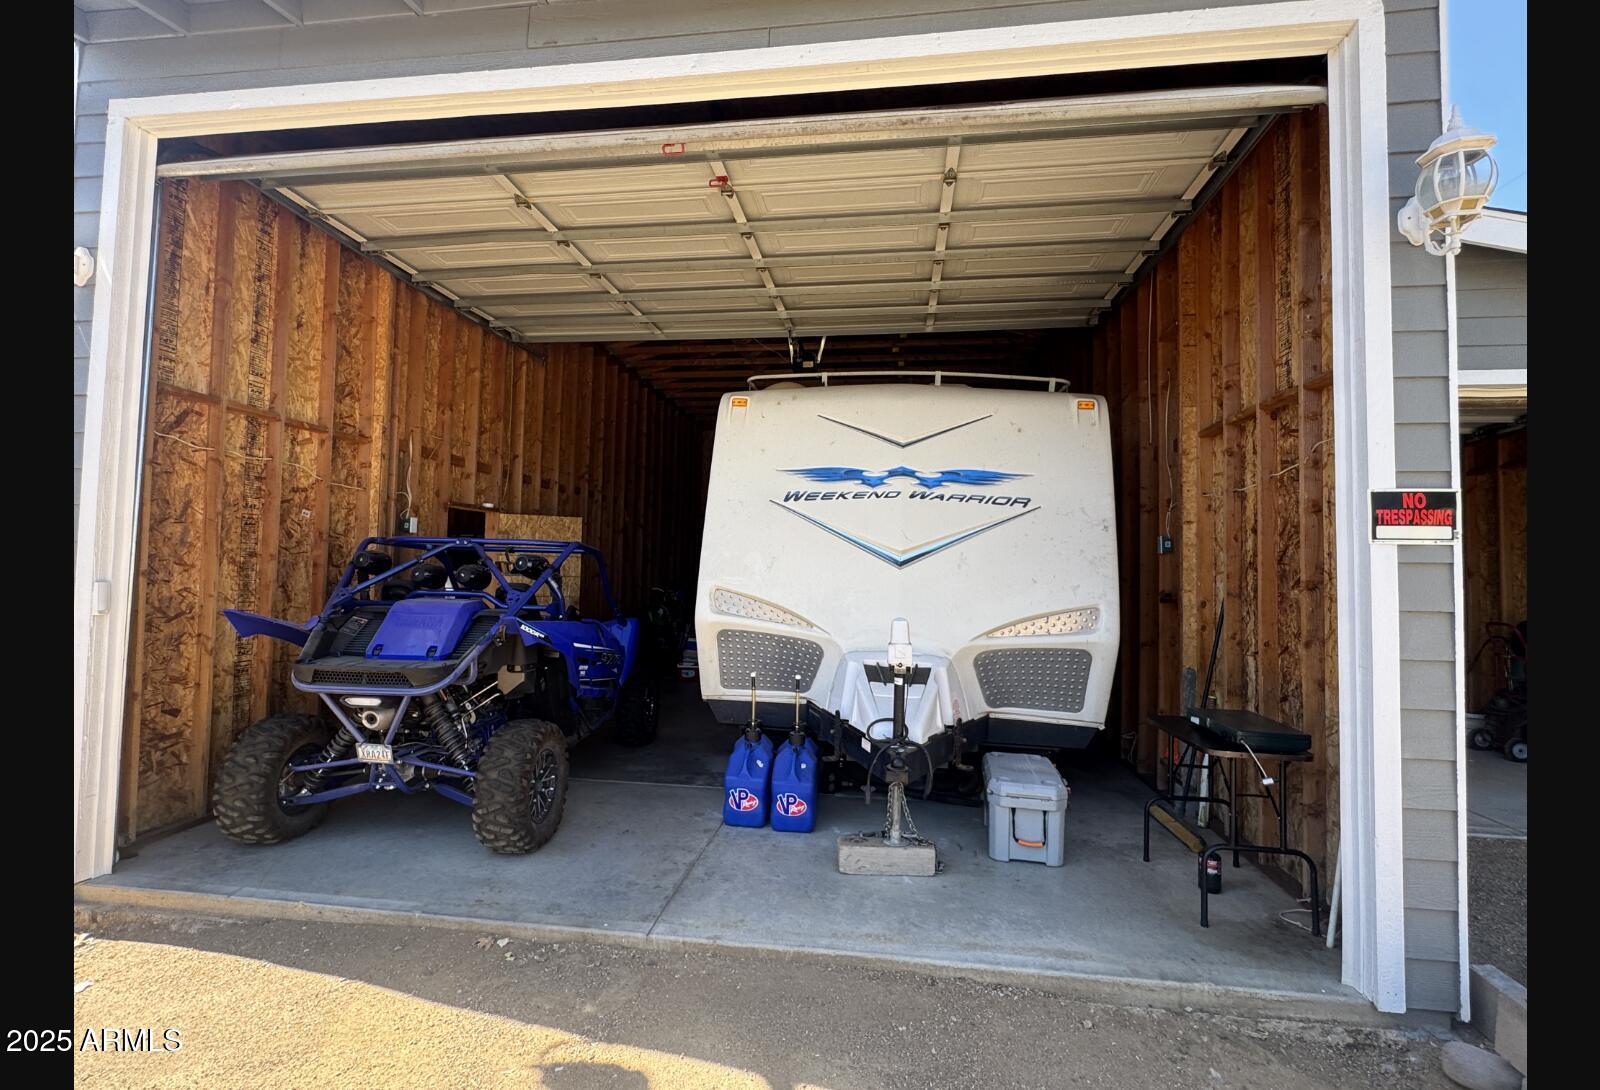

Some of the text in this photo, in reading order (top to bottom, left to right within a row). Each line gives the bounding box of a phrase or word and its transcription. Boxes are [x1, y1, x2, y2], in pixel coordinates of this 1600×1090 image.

[783, 489, 1032, 508] WEEKEND WARRIOR
[1402, 493, 1426, 508] NO
[1376, 509, 1453, 525] TRESPASSING
[729, 788, 750, 811] VP
[777, 793, 798, 816] VP
